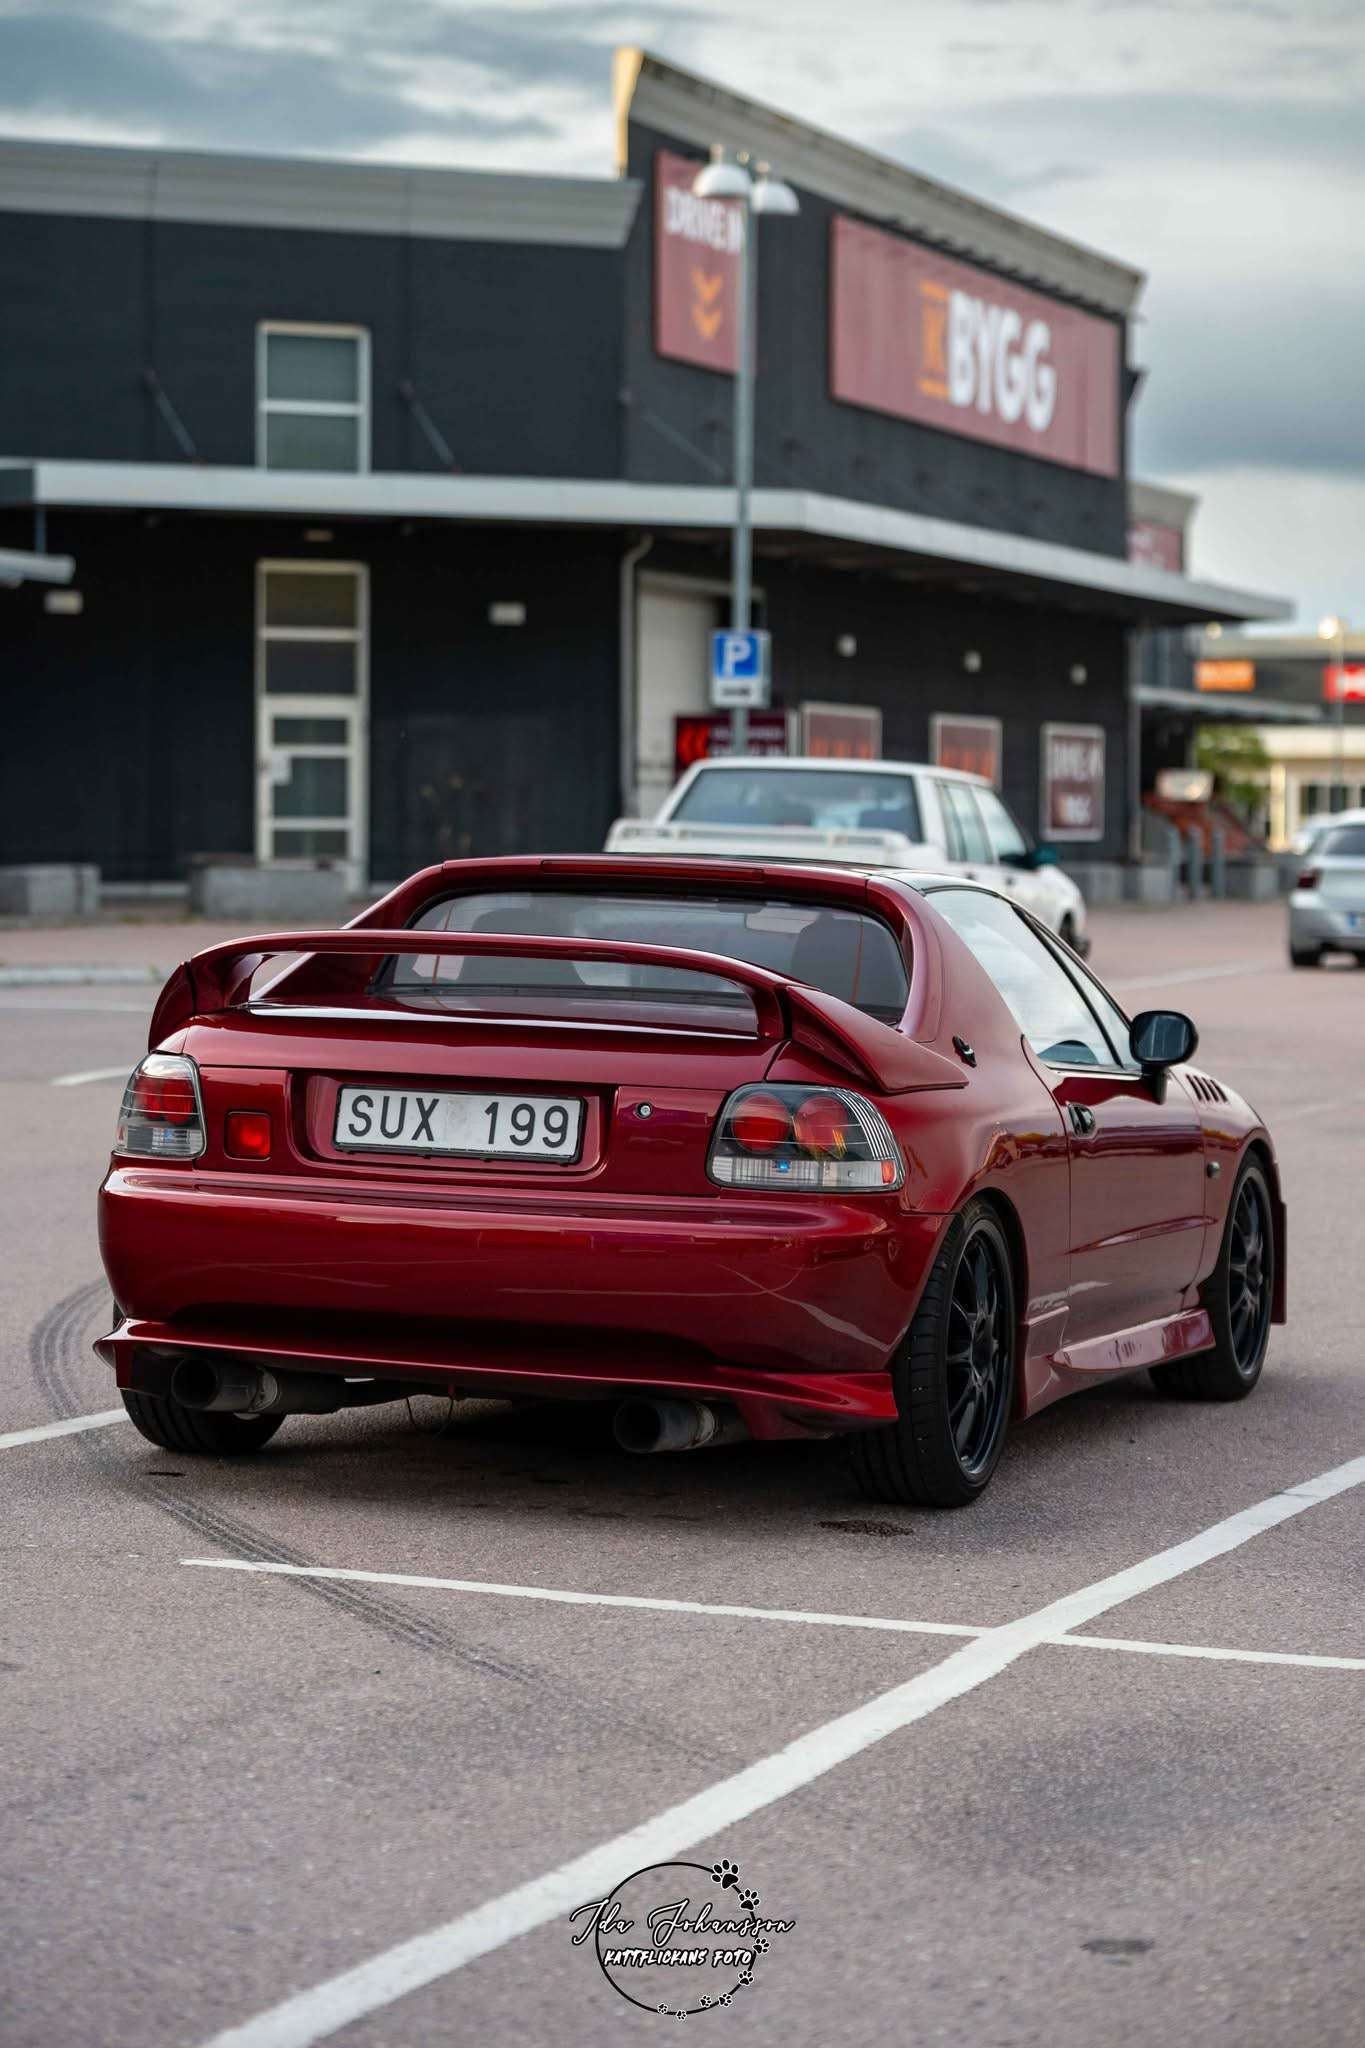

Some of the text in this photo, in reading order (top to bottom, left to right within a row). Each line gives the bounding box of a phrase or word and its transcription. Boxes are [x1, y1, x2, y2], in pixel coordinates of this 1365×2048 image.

[724, 638, 751, 677] P
[348, 1094, 569, 1148] SUX 199
